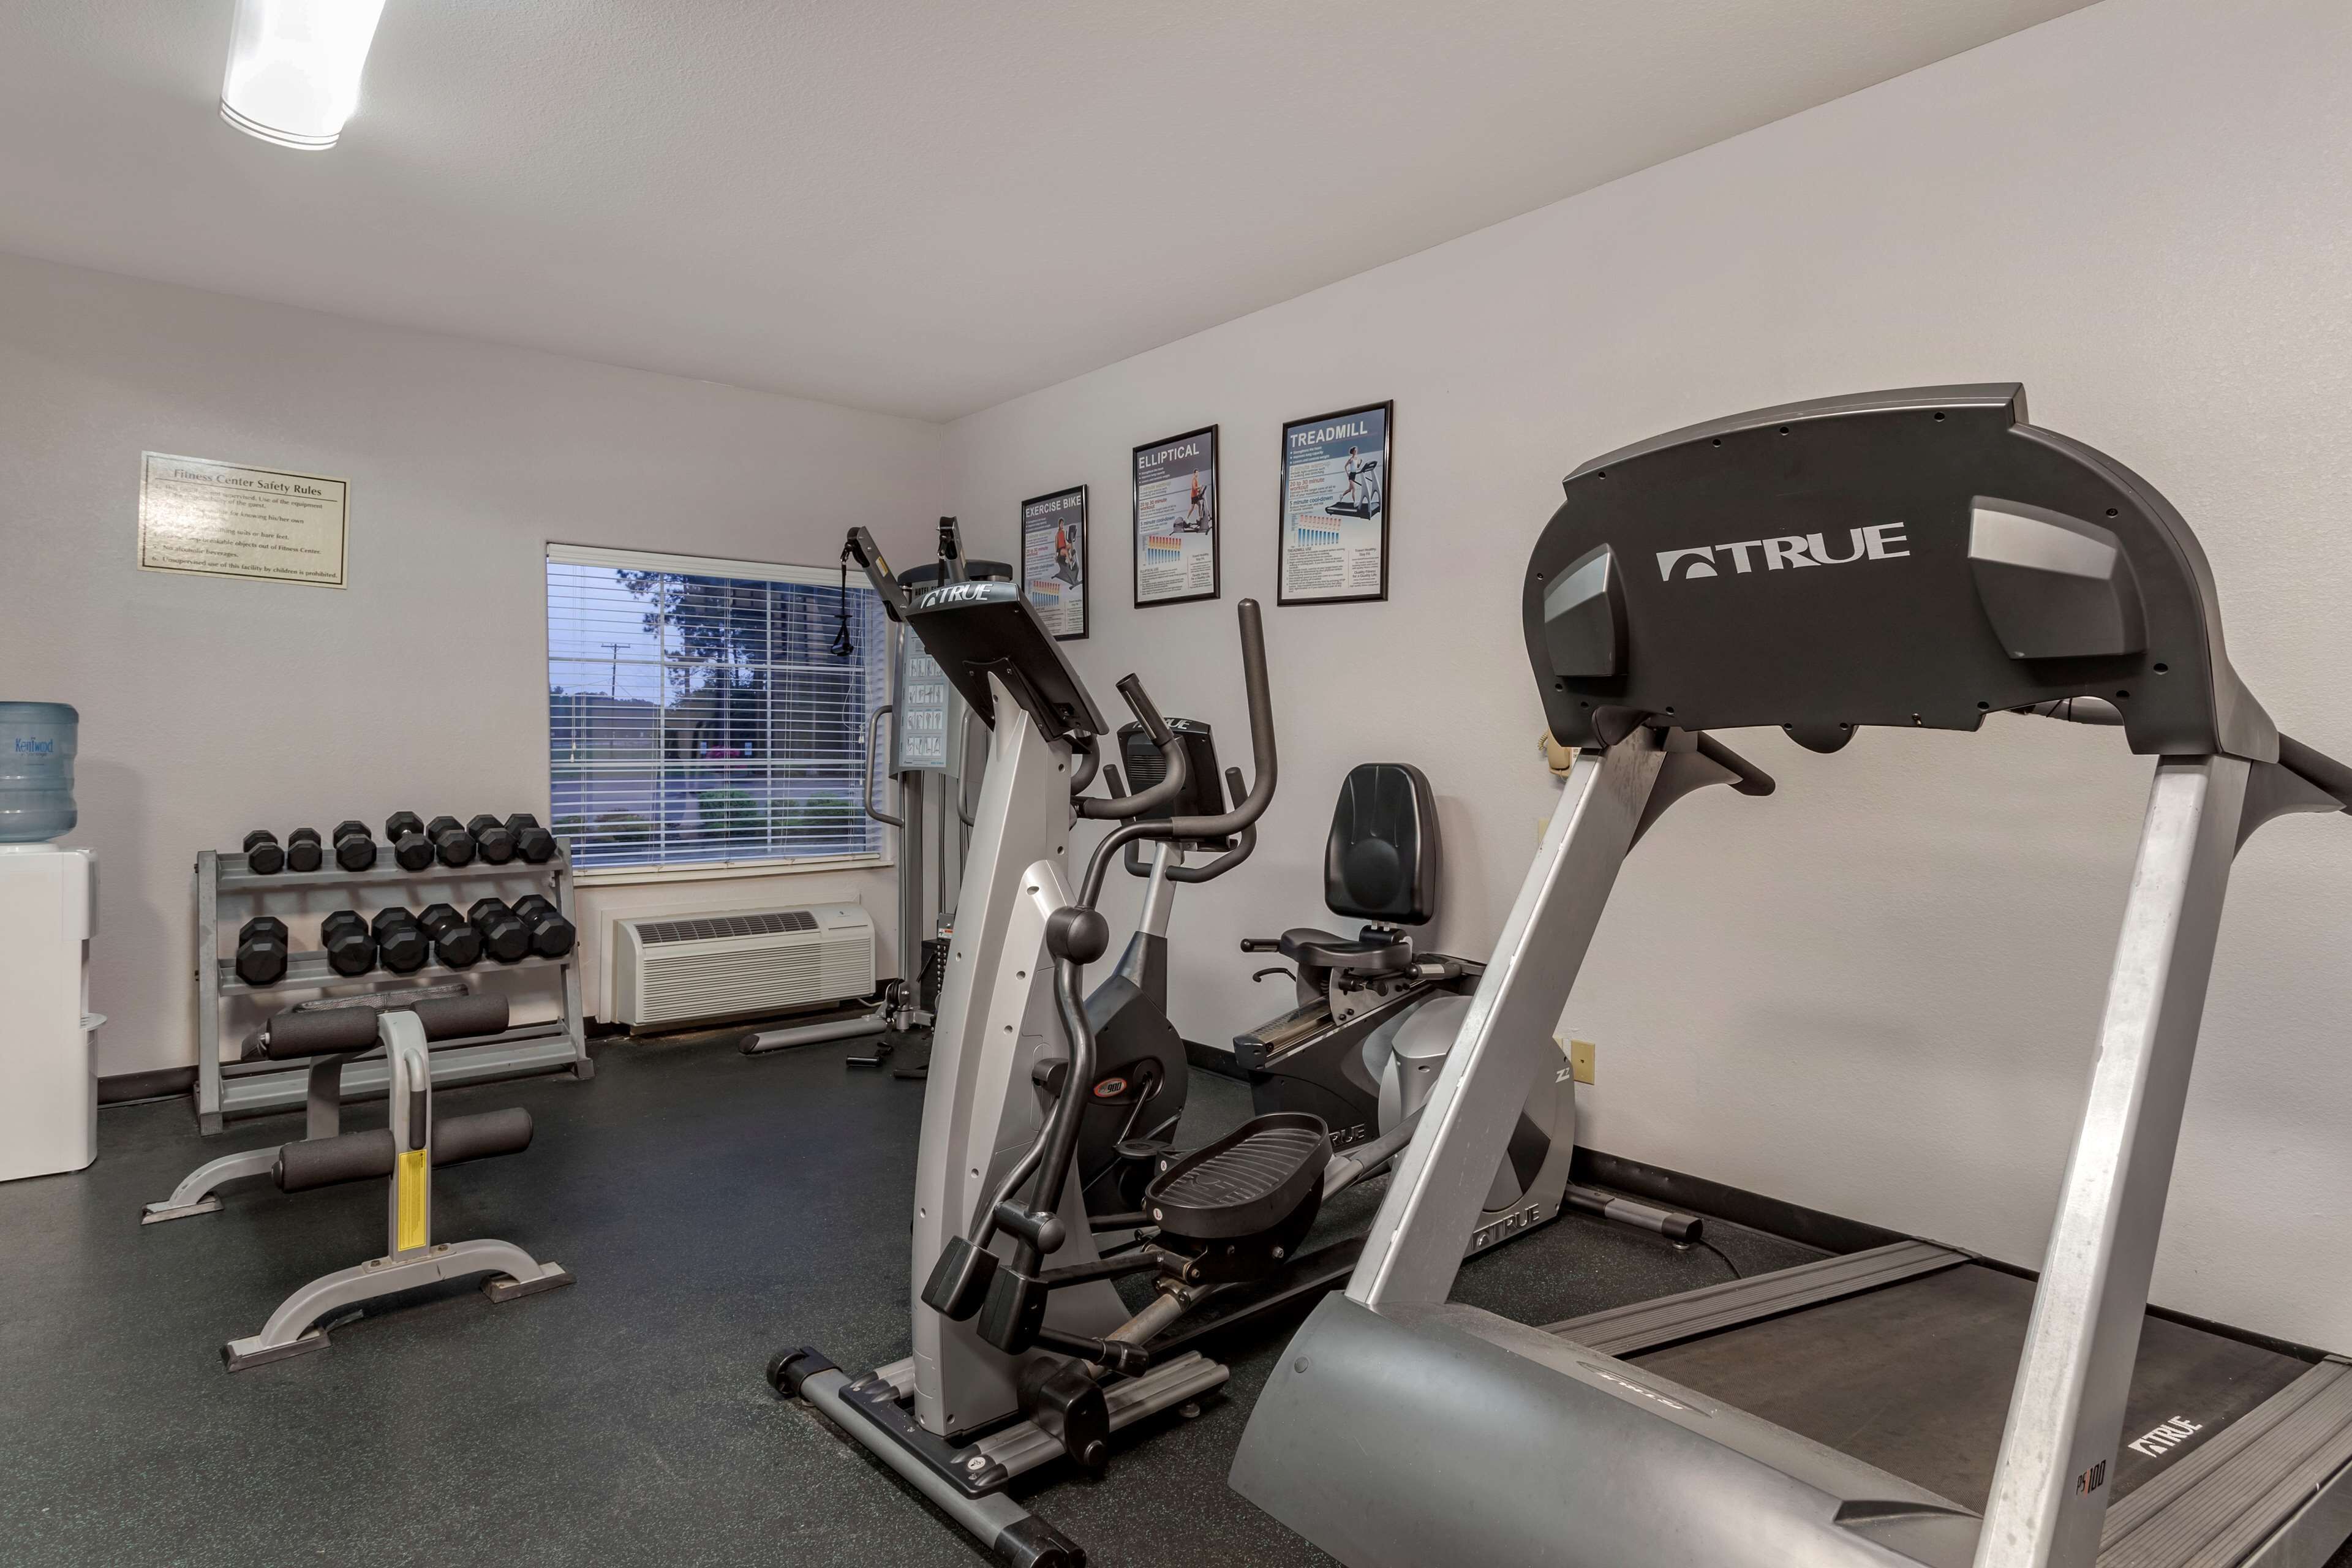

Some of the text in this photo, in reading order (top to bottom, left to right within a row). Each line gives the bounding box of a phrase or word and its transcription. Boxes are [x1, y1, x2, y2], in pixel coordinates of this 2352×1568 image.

[1291, 421, 1368, 447] TREADMILL
[1139, 443, 1199, 469] ELLIPTICAL
[174, 469, 322, 496] Fitness Center Safety Rules
[1026, 495, 1082, 518] EXERCISE BIKE
[1309, 494, 1333, 503] cool-down
[241, 511, 266, 521] knowing
[206, 549, 239, 557] beverages.
[1715, 522, 1910, 573] TRUE
[162, 556, 206, 566] Unsupervised
[241, 564, 263, 572] facility
[940, 584, 993, 603] TRUE
[15, 737, 54, 753] Kentwood
[1329, 1123, 1365, 1147] RUE
[1490, 1204, 1539, 1240] TRUE
[2141, 1415, 2203, 1447] TRUE
